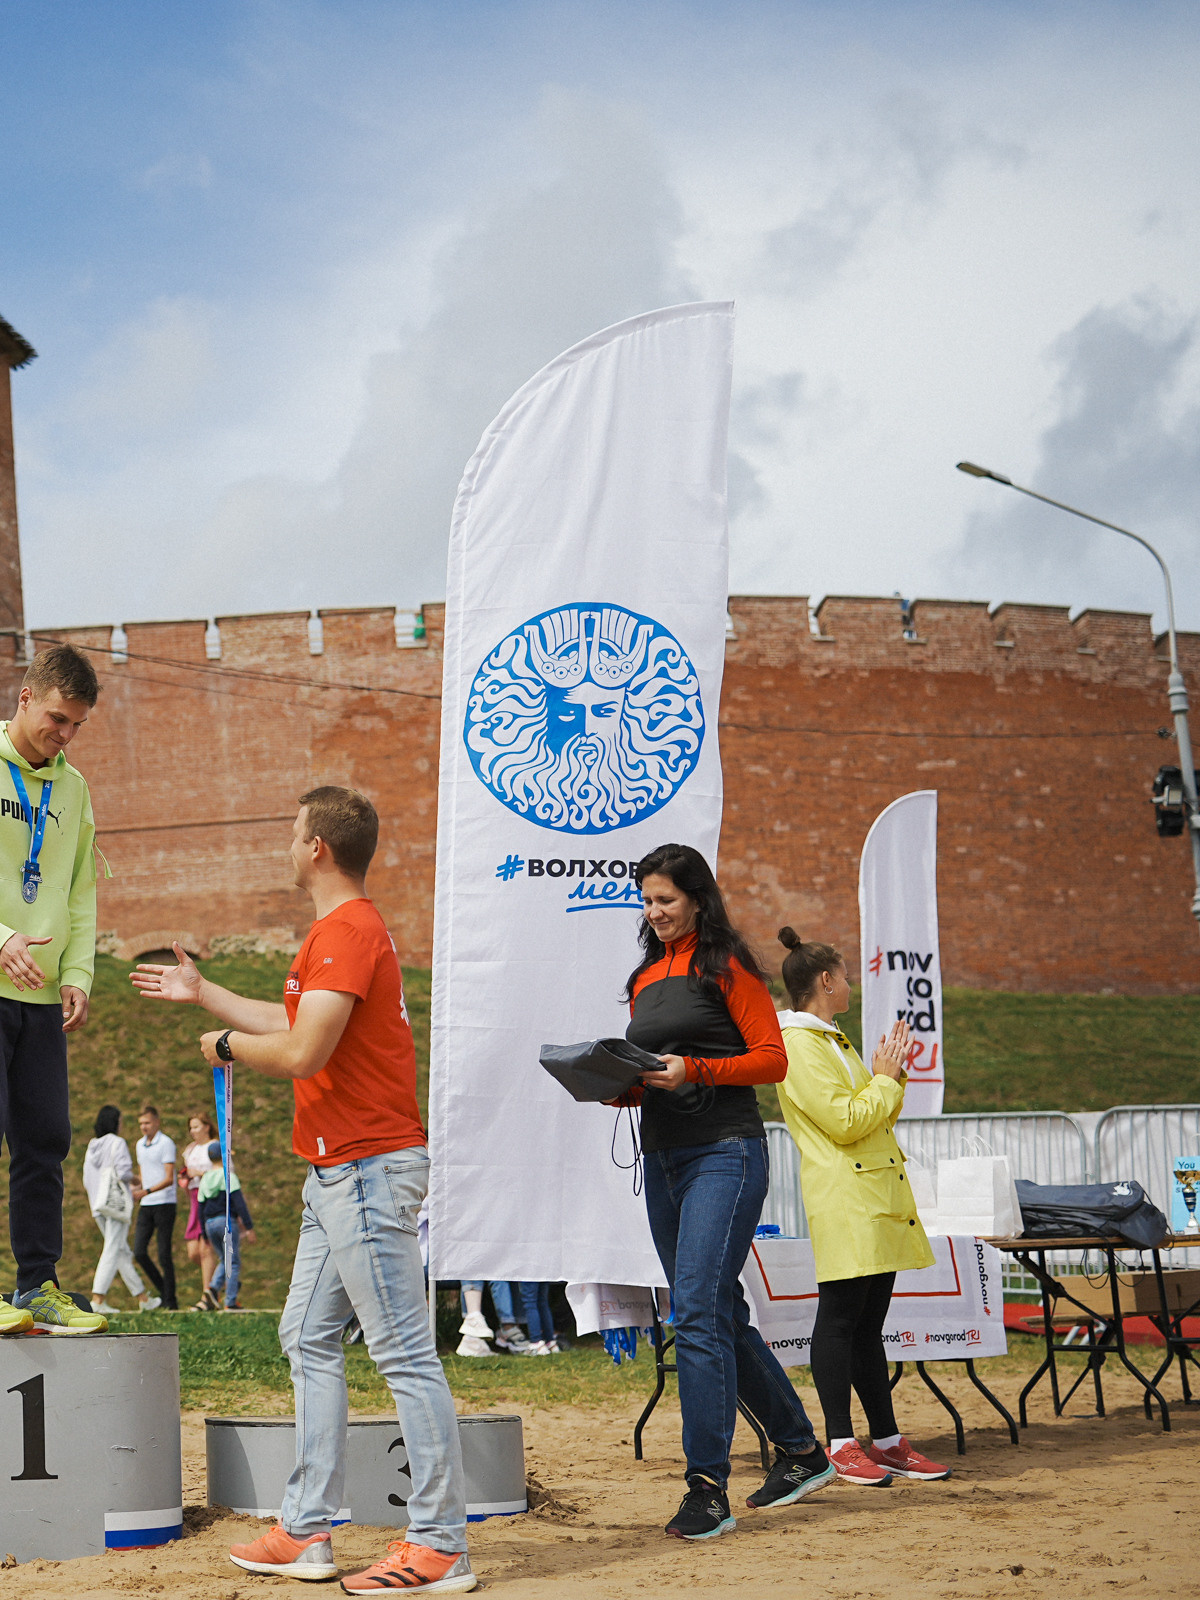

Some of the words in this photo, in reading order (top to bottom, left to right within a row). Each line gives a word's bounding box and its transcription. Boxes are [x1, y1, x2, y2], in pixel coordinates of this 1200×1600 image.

[1, 799, 40, 825] PU
[904, 1040, 938, 1072] RI
[1178, 1161, 1196, 1170] You
[7, 1373, 58, 1480] 1
